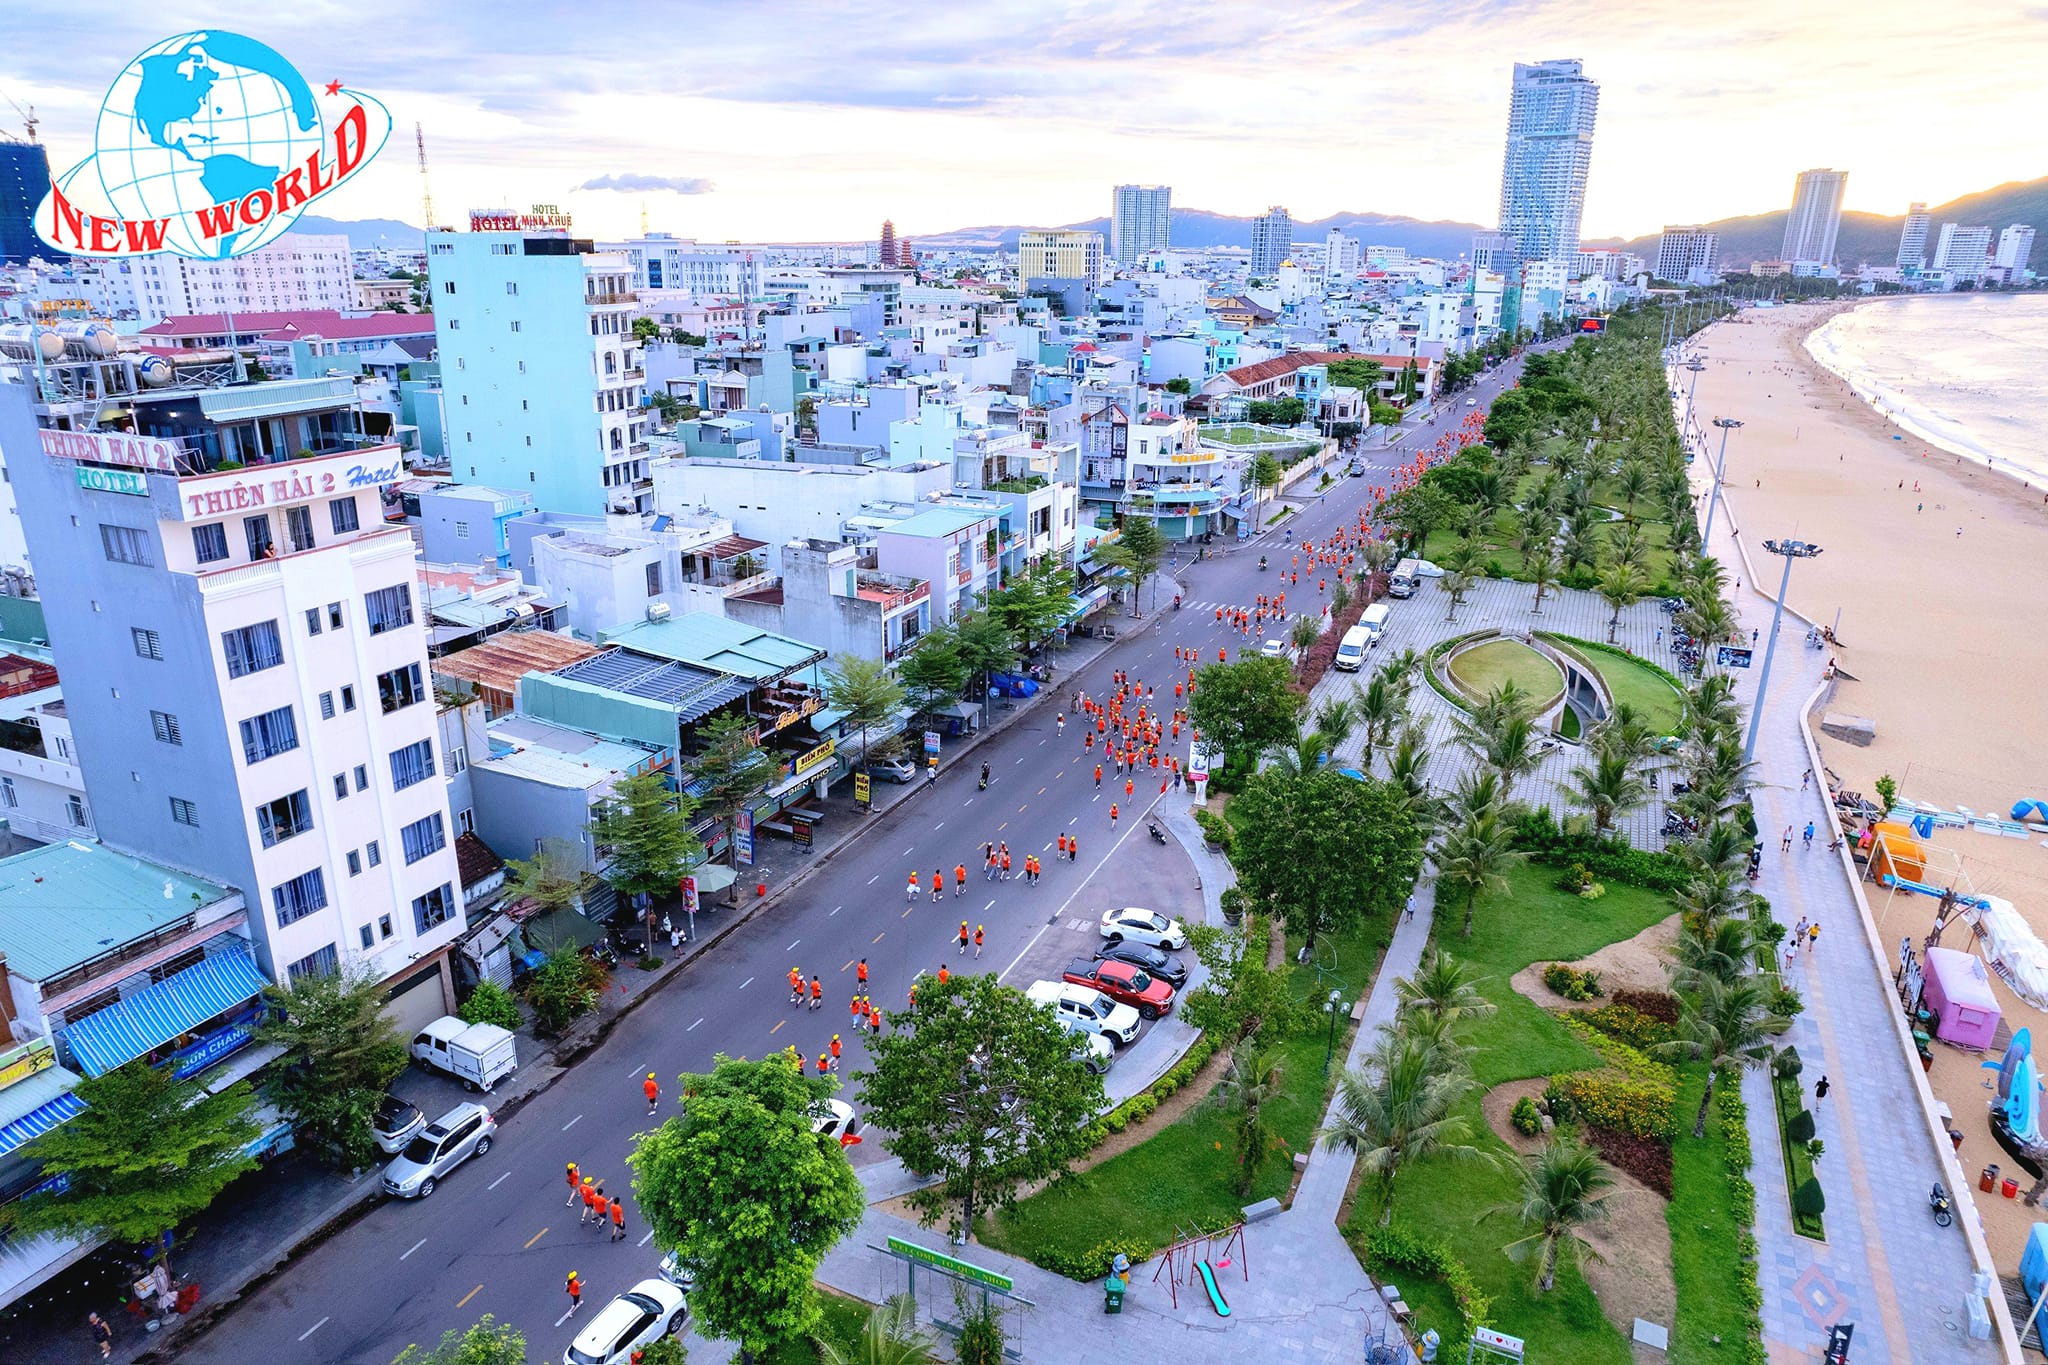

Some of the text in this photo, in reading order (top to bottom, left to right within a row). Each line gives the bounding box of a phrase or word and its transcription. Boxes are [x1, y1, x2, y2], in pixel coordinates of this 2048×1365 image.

[531, 204, 559, 214] HOTEL
[471, 214, 522, 232] HOTEL
[41, 300, 97, 312] HOTEL
[154, 443, 169, 470] 2
[75, 467, 145, 494] HOTEL
[188, 461, 400, 517] THIÊN HẢI 2 Hotel
[890, 1241, 936, 1262] WELCOME
[942, 1260, 954, 1269] TO
[983, 1274, 1009, 1289] NHON
